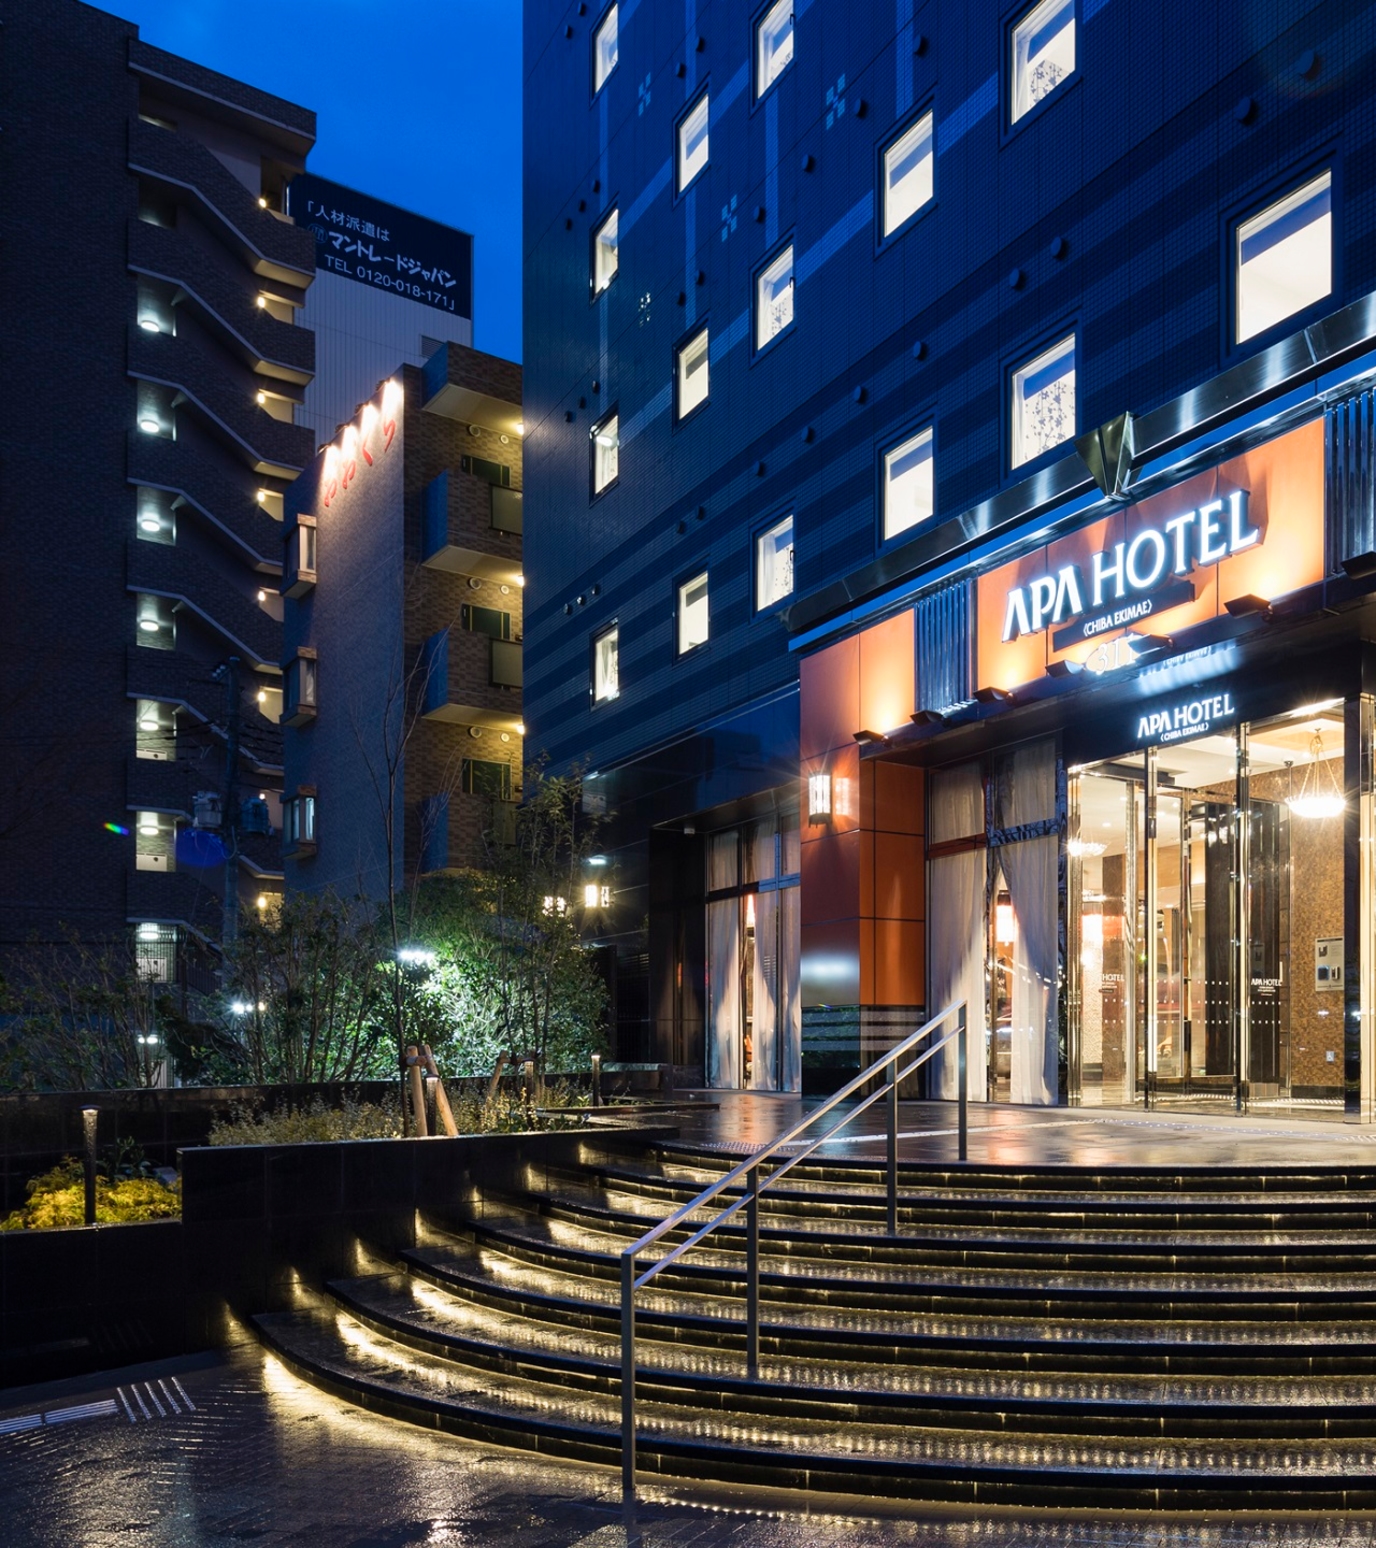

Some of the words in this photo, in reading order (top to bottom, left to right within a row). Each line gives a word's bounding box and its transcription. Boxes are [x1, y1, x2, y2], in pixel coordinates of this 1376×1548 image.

[324, 254, 353, 275] TEL
[329, 231, 457, 288] マントレードジャパン
[1002, 564, 1084, 643] APA
[1092, 489, 1260, 607] HOTEL
[1137, 710, 1172, 739] APA
[1173, 693, 1235, 729] HOTEL
[1101, 973, 1125, 982] HOTEL
